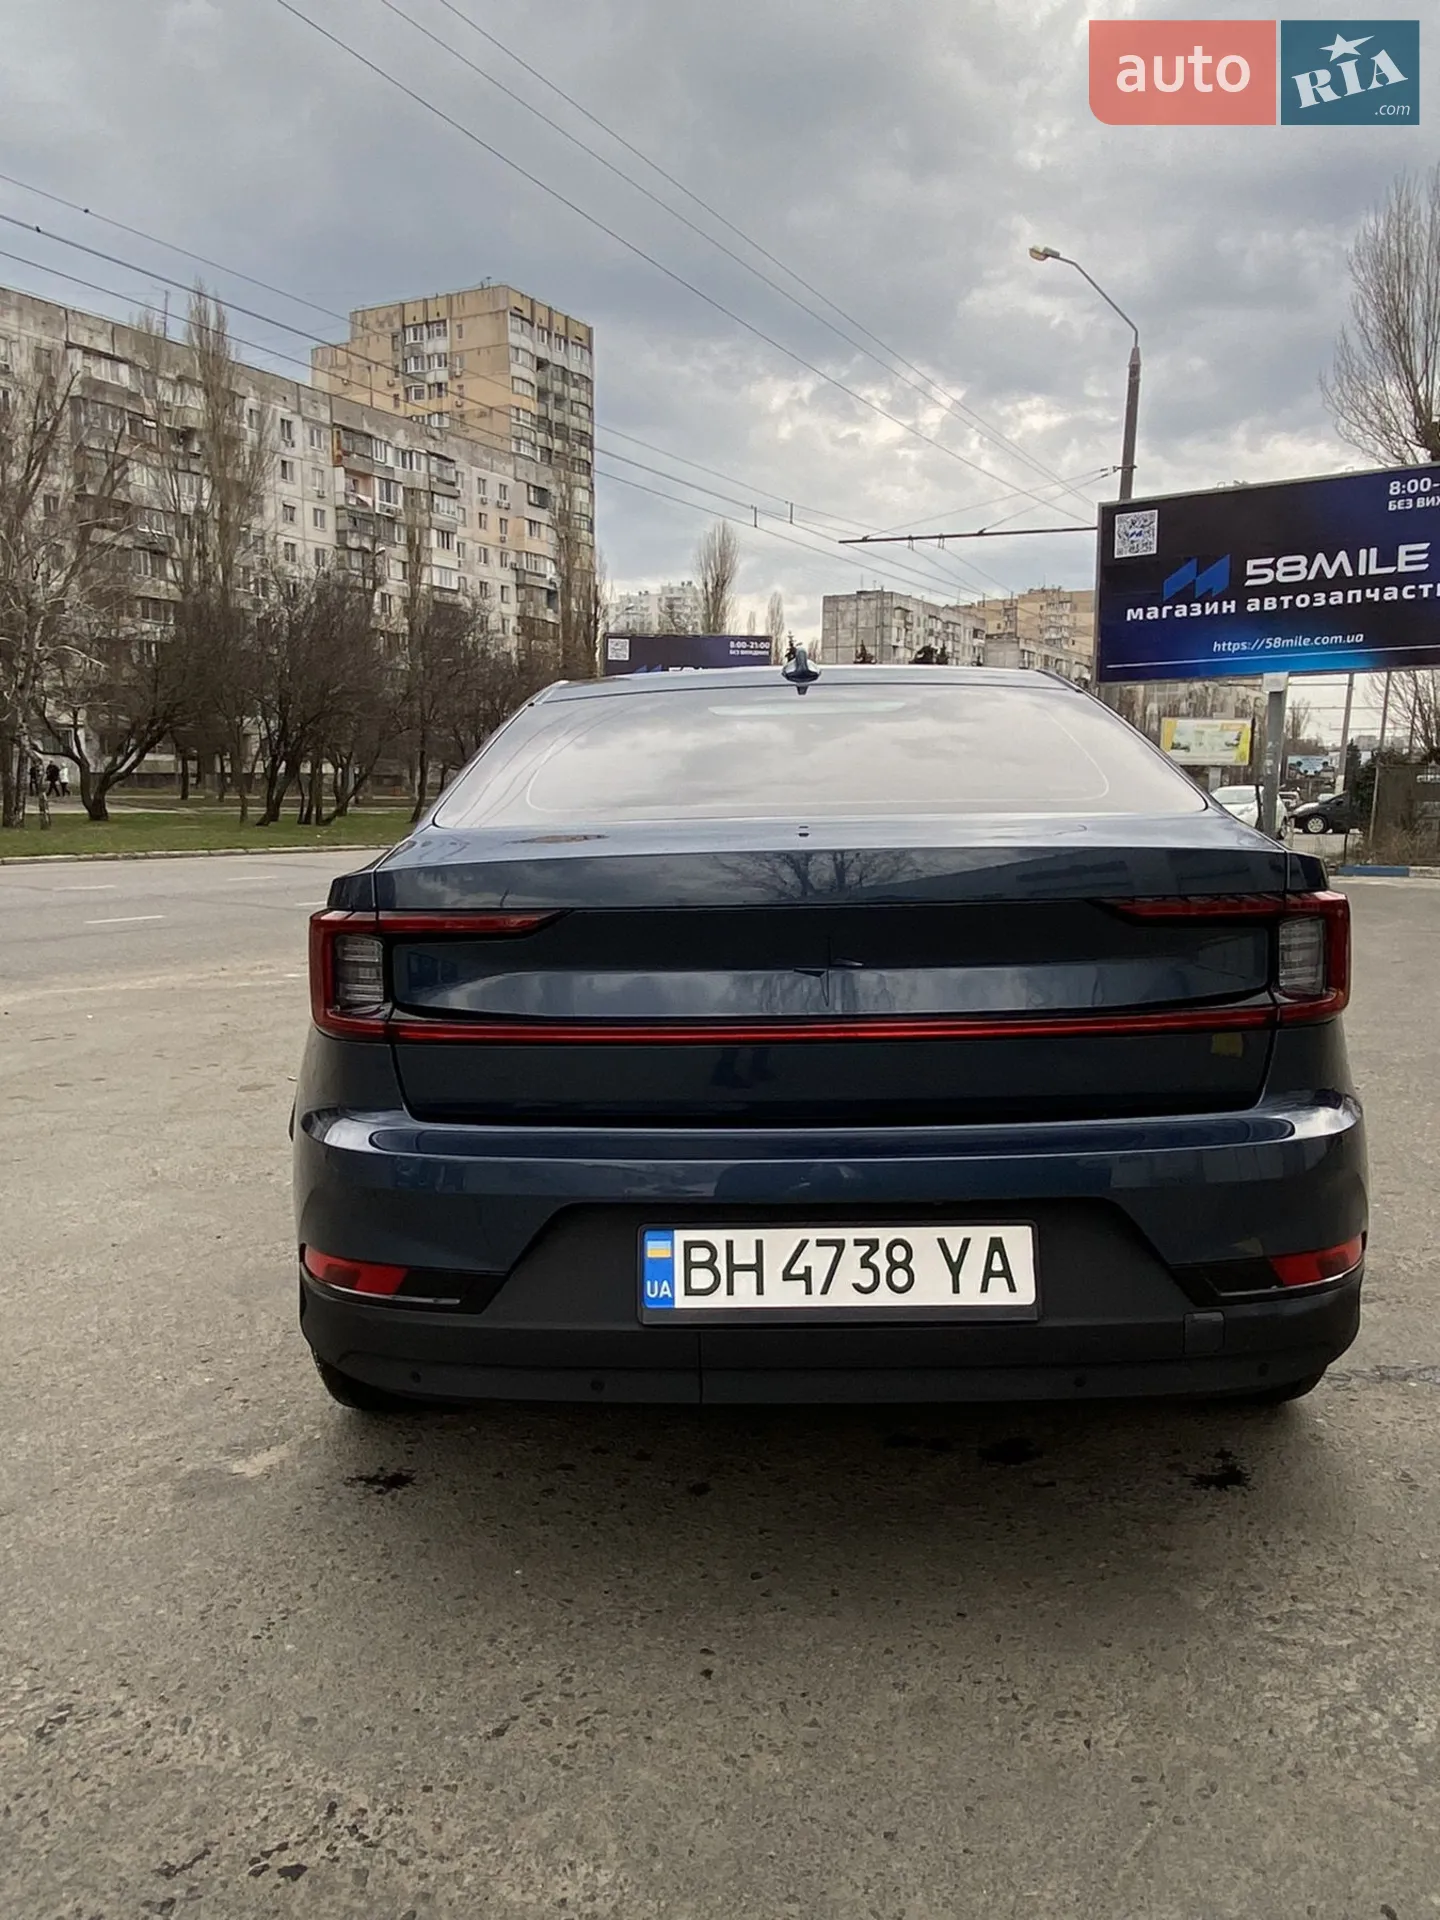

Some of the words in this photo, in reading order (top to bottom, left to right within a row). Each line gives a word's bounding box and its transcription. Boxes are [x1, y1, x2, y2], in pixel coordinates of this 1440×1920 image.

[1388, 498, 1413, 511] БЕЗ
[1244, 542, 1431, 587] 58MILE
[1126, 599, 1236, 622] магазин
[1212, 632, 1364, 653] https://58mile.com.ua
[683, 1239, 764, 1296] BH
[782, 1238, 915, 1295] 4738
[937, 1236, 1017, 1294] YA
[646, 1281, 672, 1298] UA
